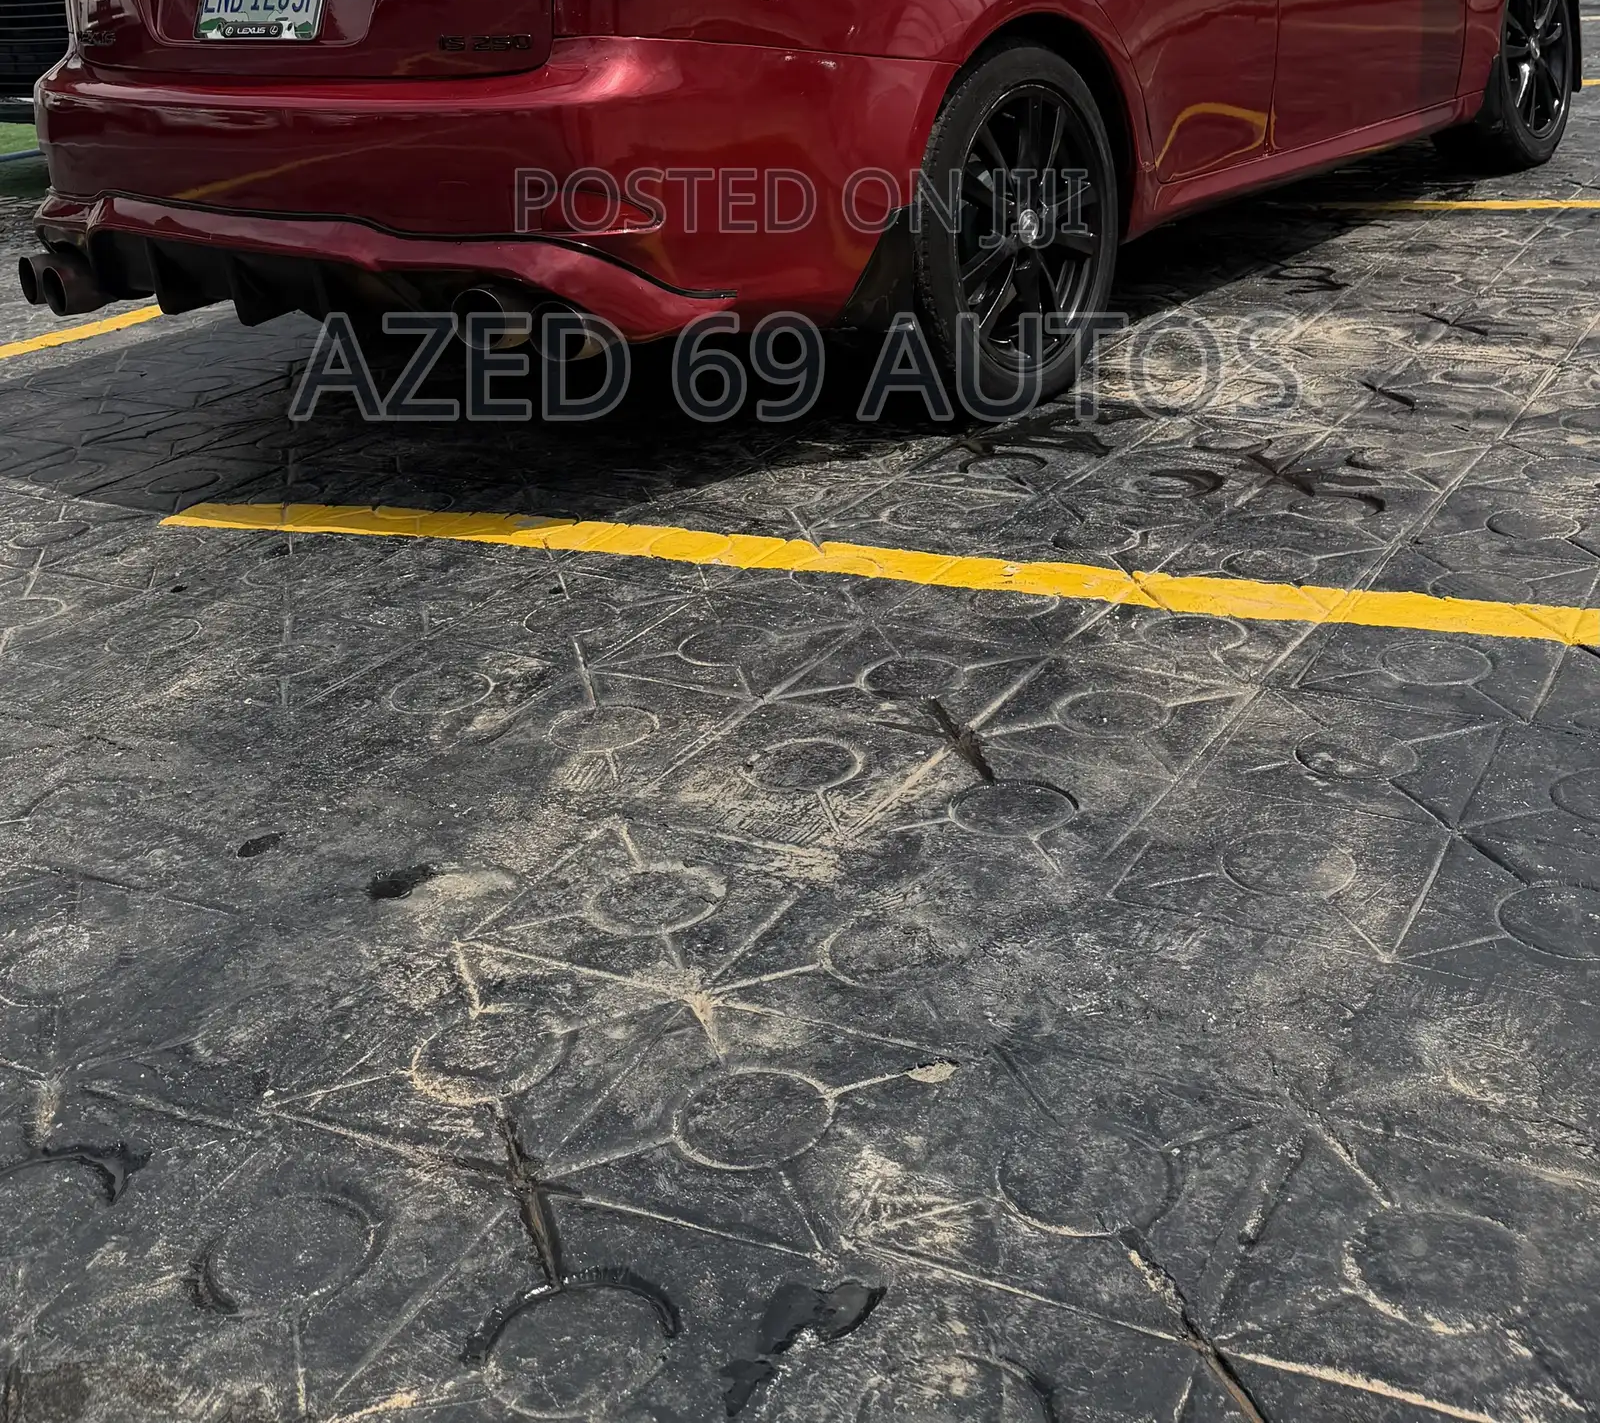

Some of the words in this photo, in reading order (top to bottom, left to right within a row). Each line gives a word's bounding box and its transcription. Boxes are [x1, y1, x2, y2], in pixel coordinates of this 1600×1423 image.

[237, 26, 266, 35] LEXUS
[439, 34, 466, 52] IS
[472, 33, 534, 52] 250
